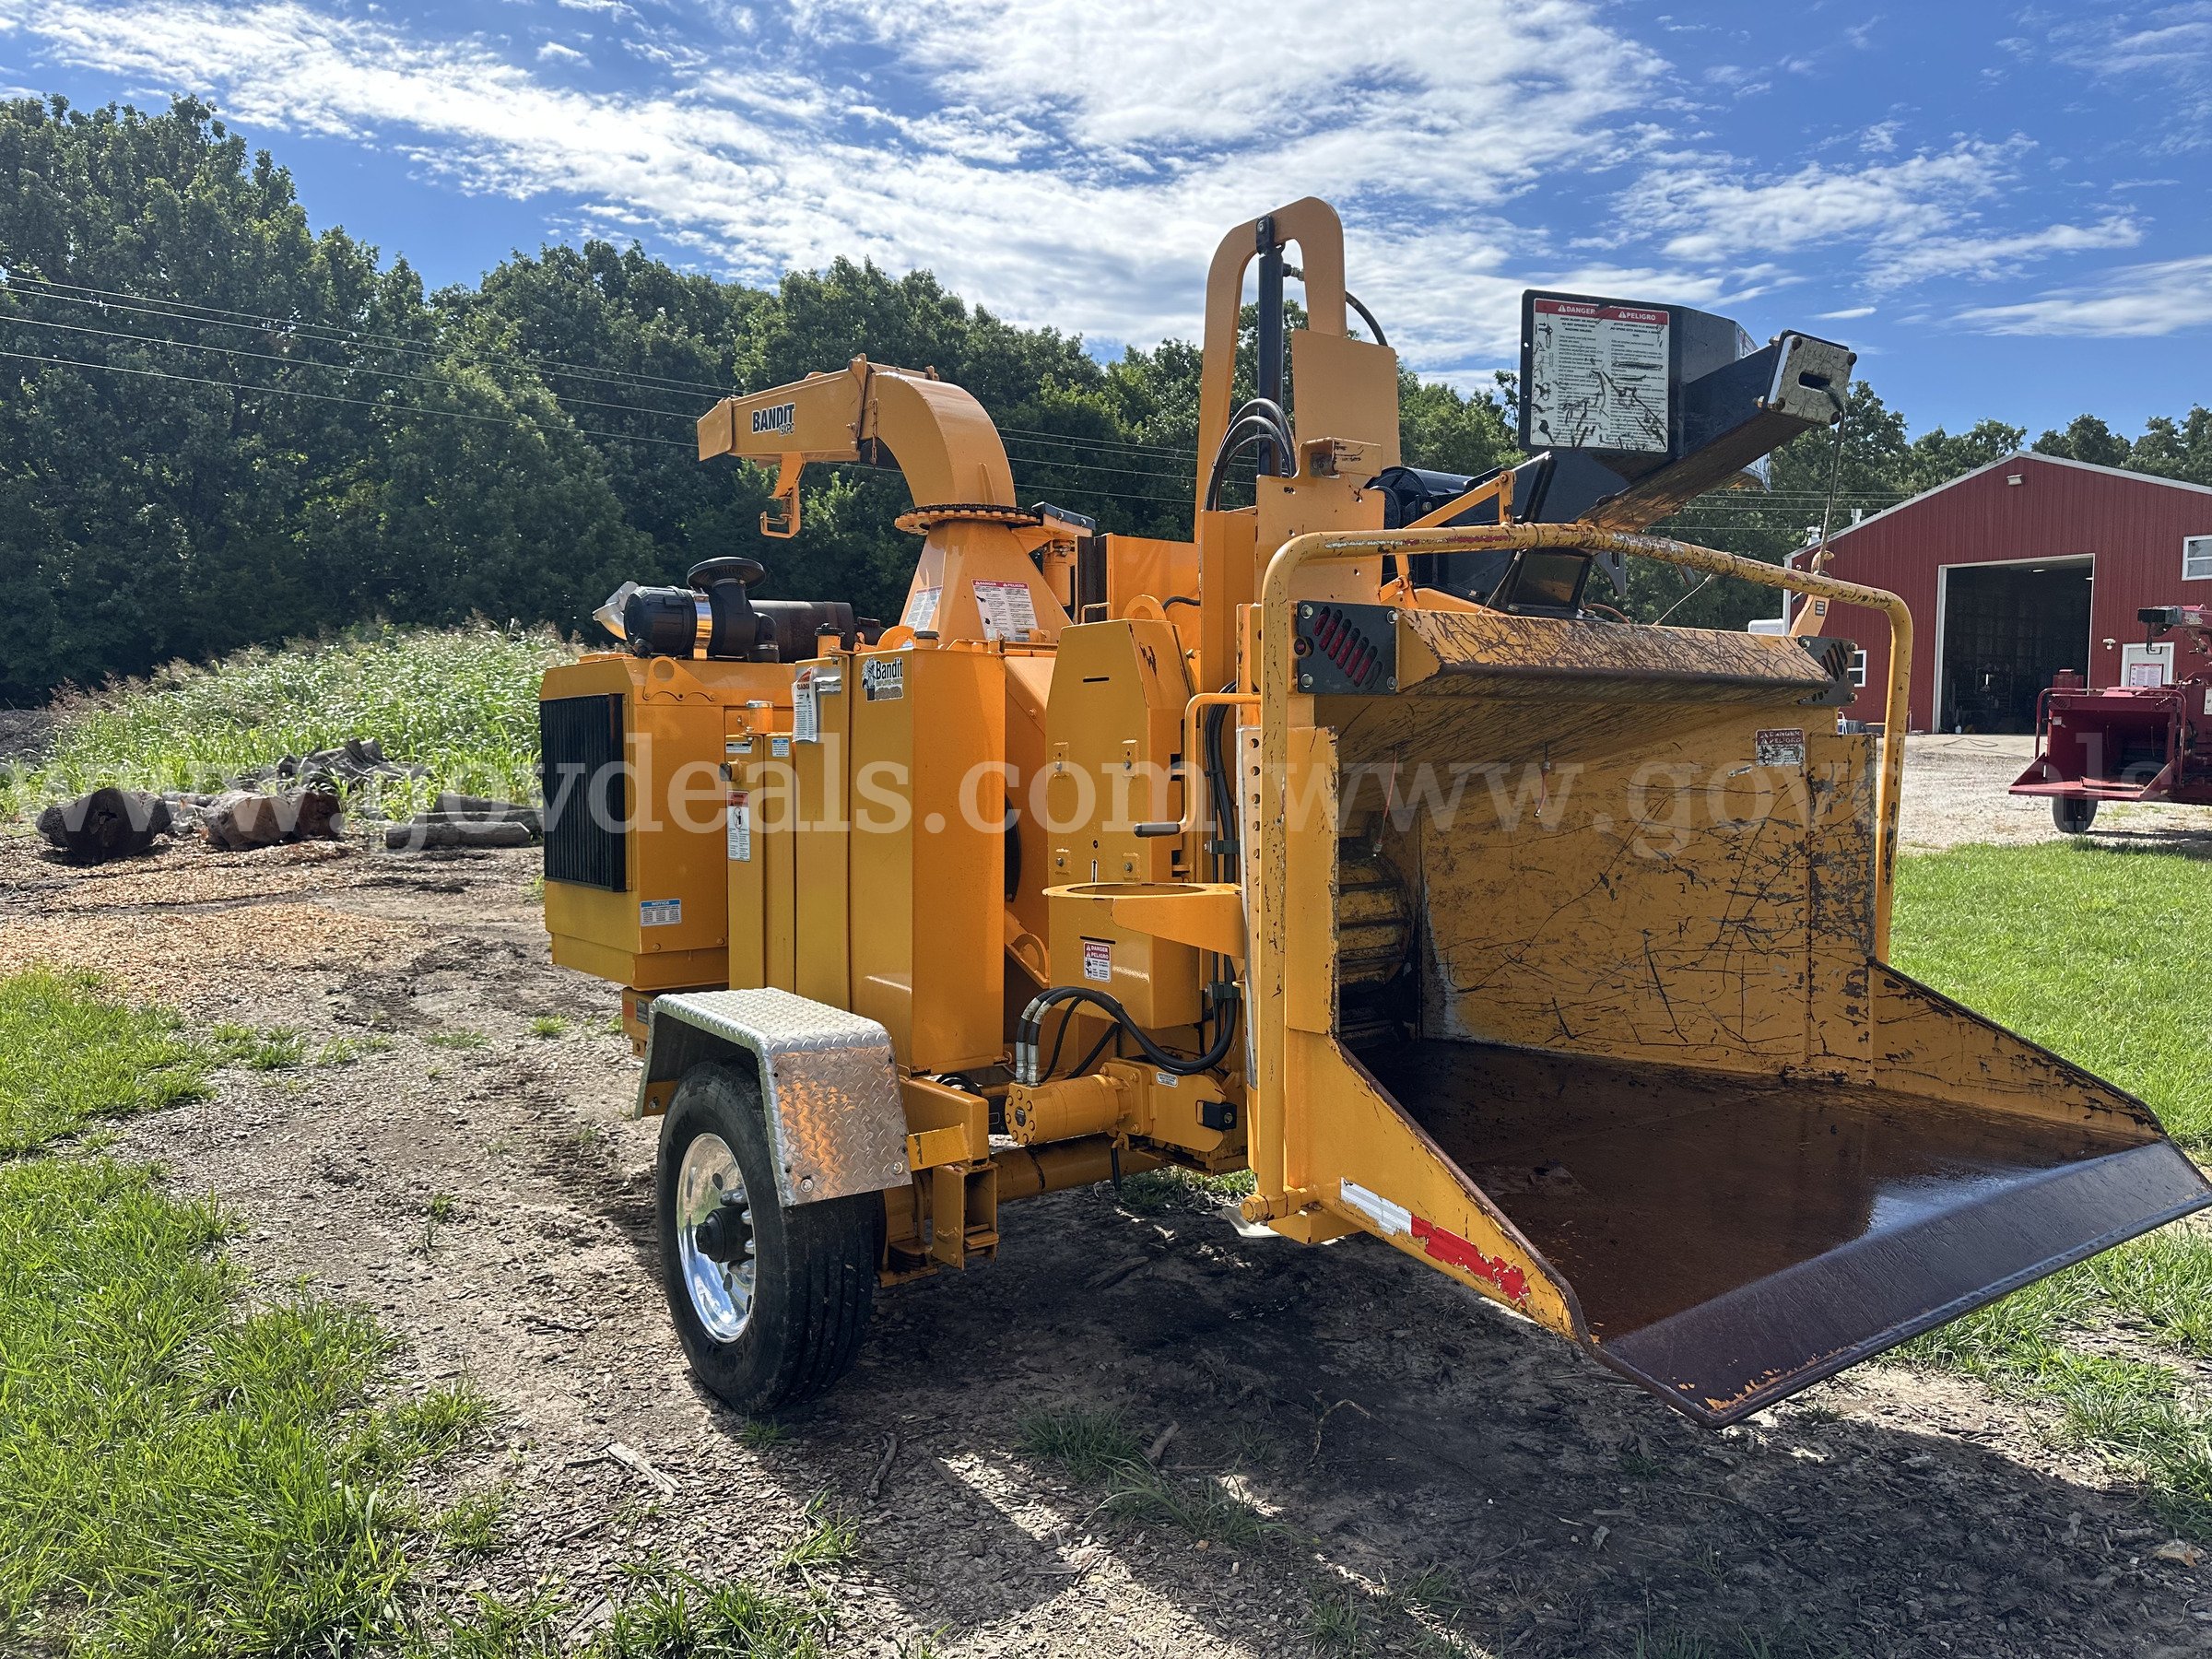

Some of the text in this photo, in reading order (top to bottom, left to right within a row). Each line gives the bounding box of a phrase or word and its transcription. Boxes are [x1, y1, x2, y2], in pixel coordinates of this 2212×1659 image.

[1566, 306, 1596, 315] DANGER
[1626, 312, 1656, 321] PELIGRO
[752, 403, 795, 433] BANDIT
[876, 657, 903, 679] Bandit
